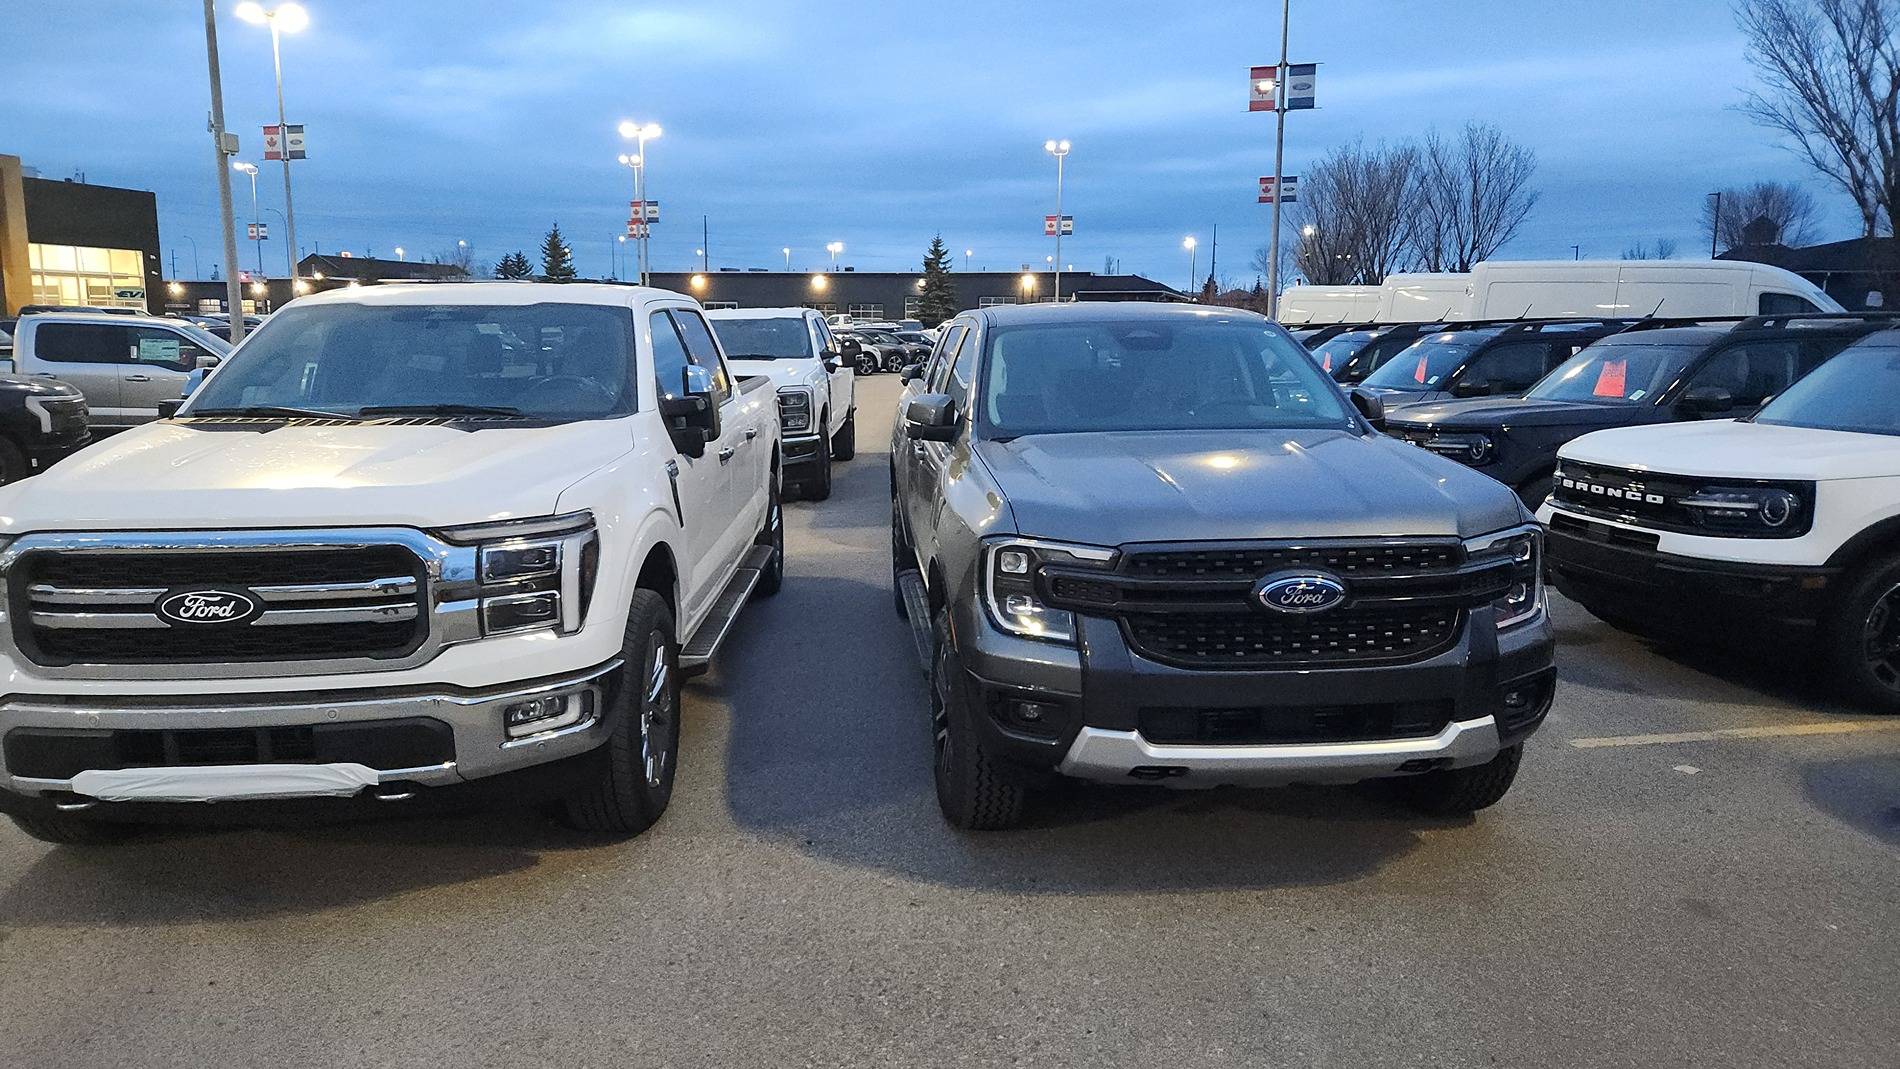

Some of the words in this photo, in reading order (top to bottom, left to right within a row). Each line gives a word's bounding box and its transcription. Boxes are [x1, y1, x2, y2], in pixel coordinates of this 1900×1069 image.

[1562, 479, 1664, 504] BRONCO
[179, 594, 236, 618] Ford
[1280, 584, 1327, 604] Ford
